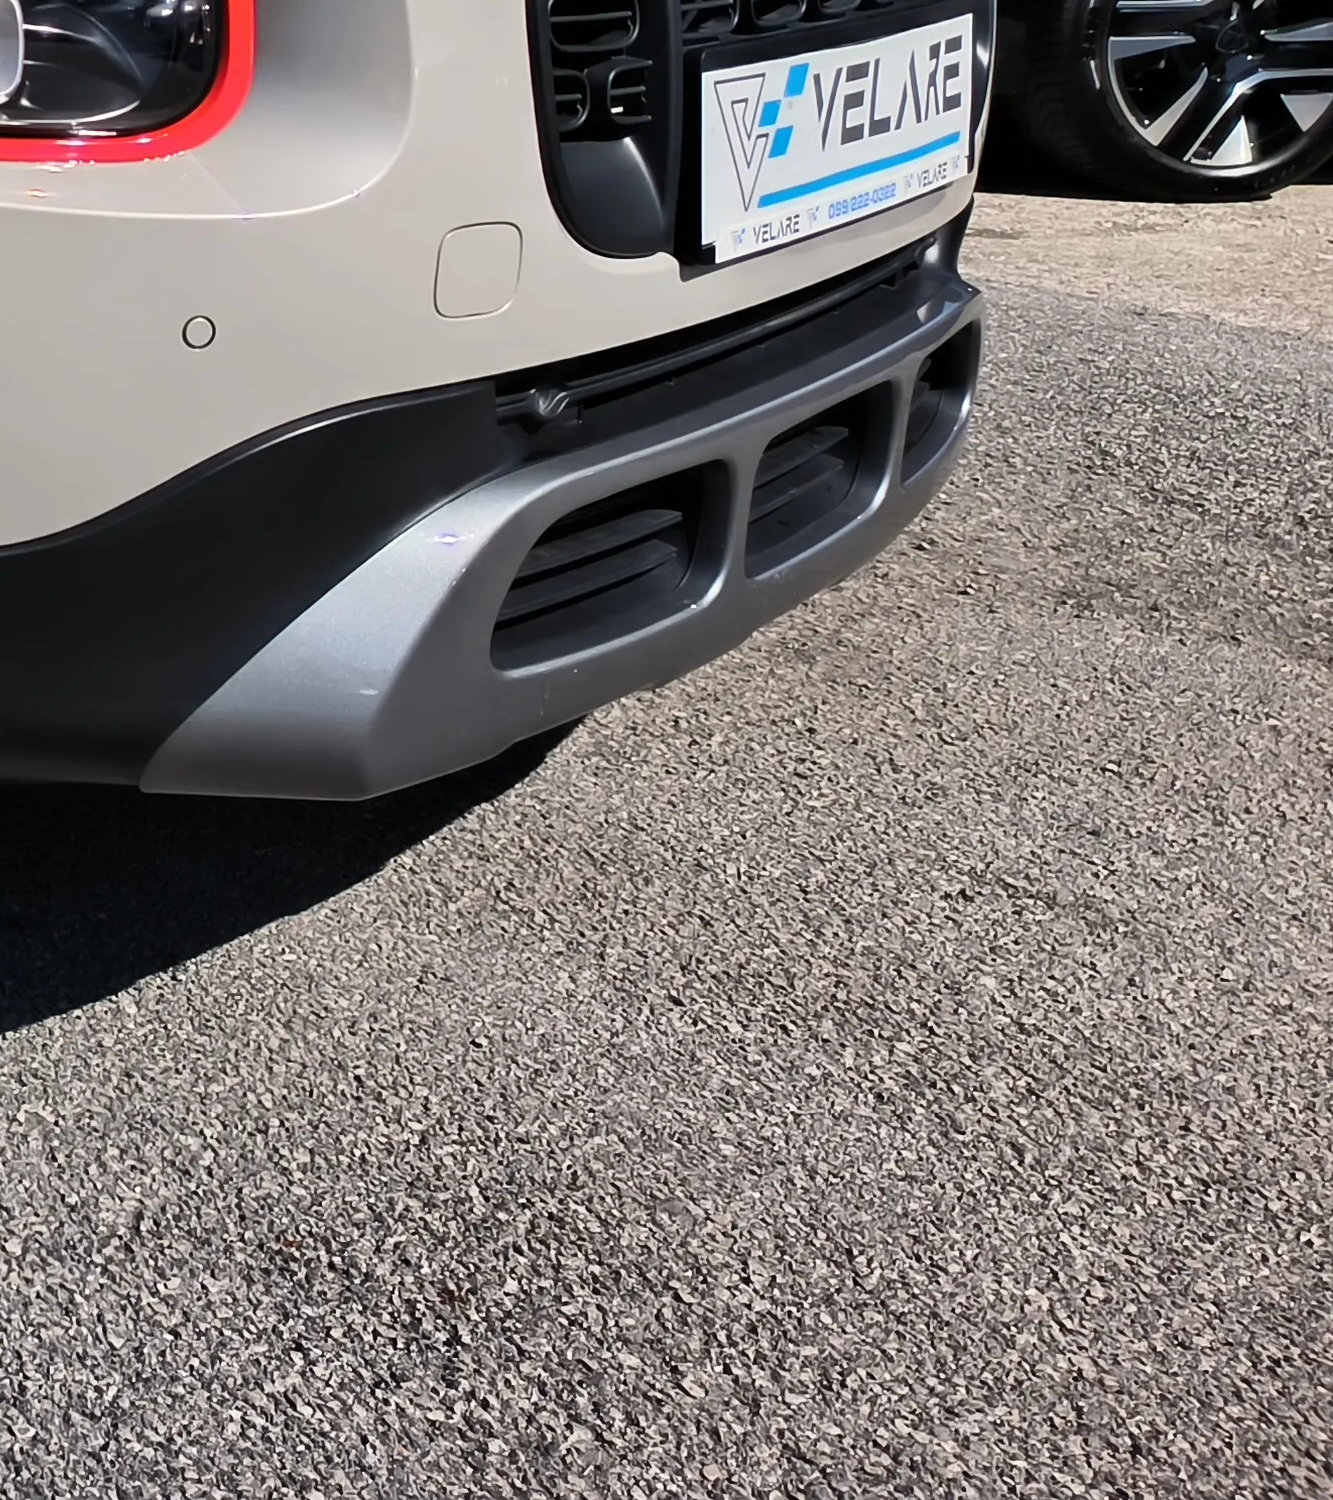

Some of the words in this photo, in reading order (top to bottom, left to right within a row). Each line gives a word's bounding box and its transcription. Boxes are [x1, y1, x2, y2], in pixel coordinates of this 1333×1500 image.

[813, 34, 963, 152] VELARE
[753, 214, 801, 244] VELARE
[916, 162, 948, 189] VELARE
